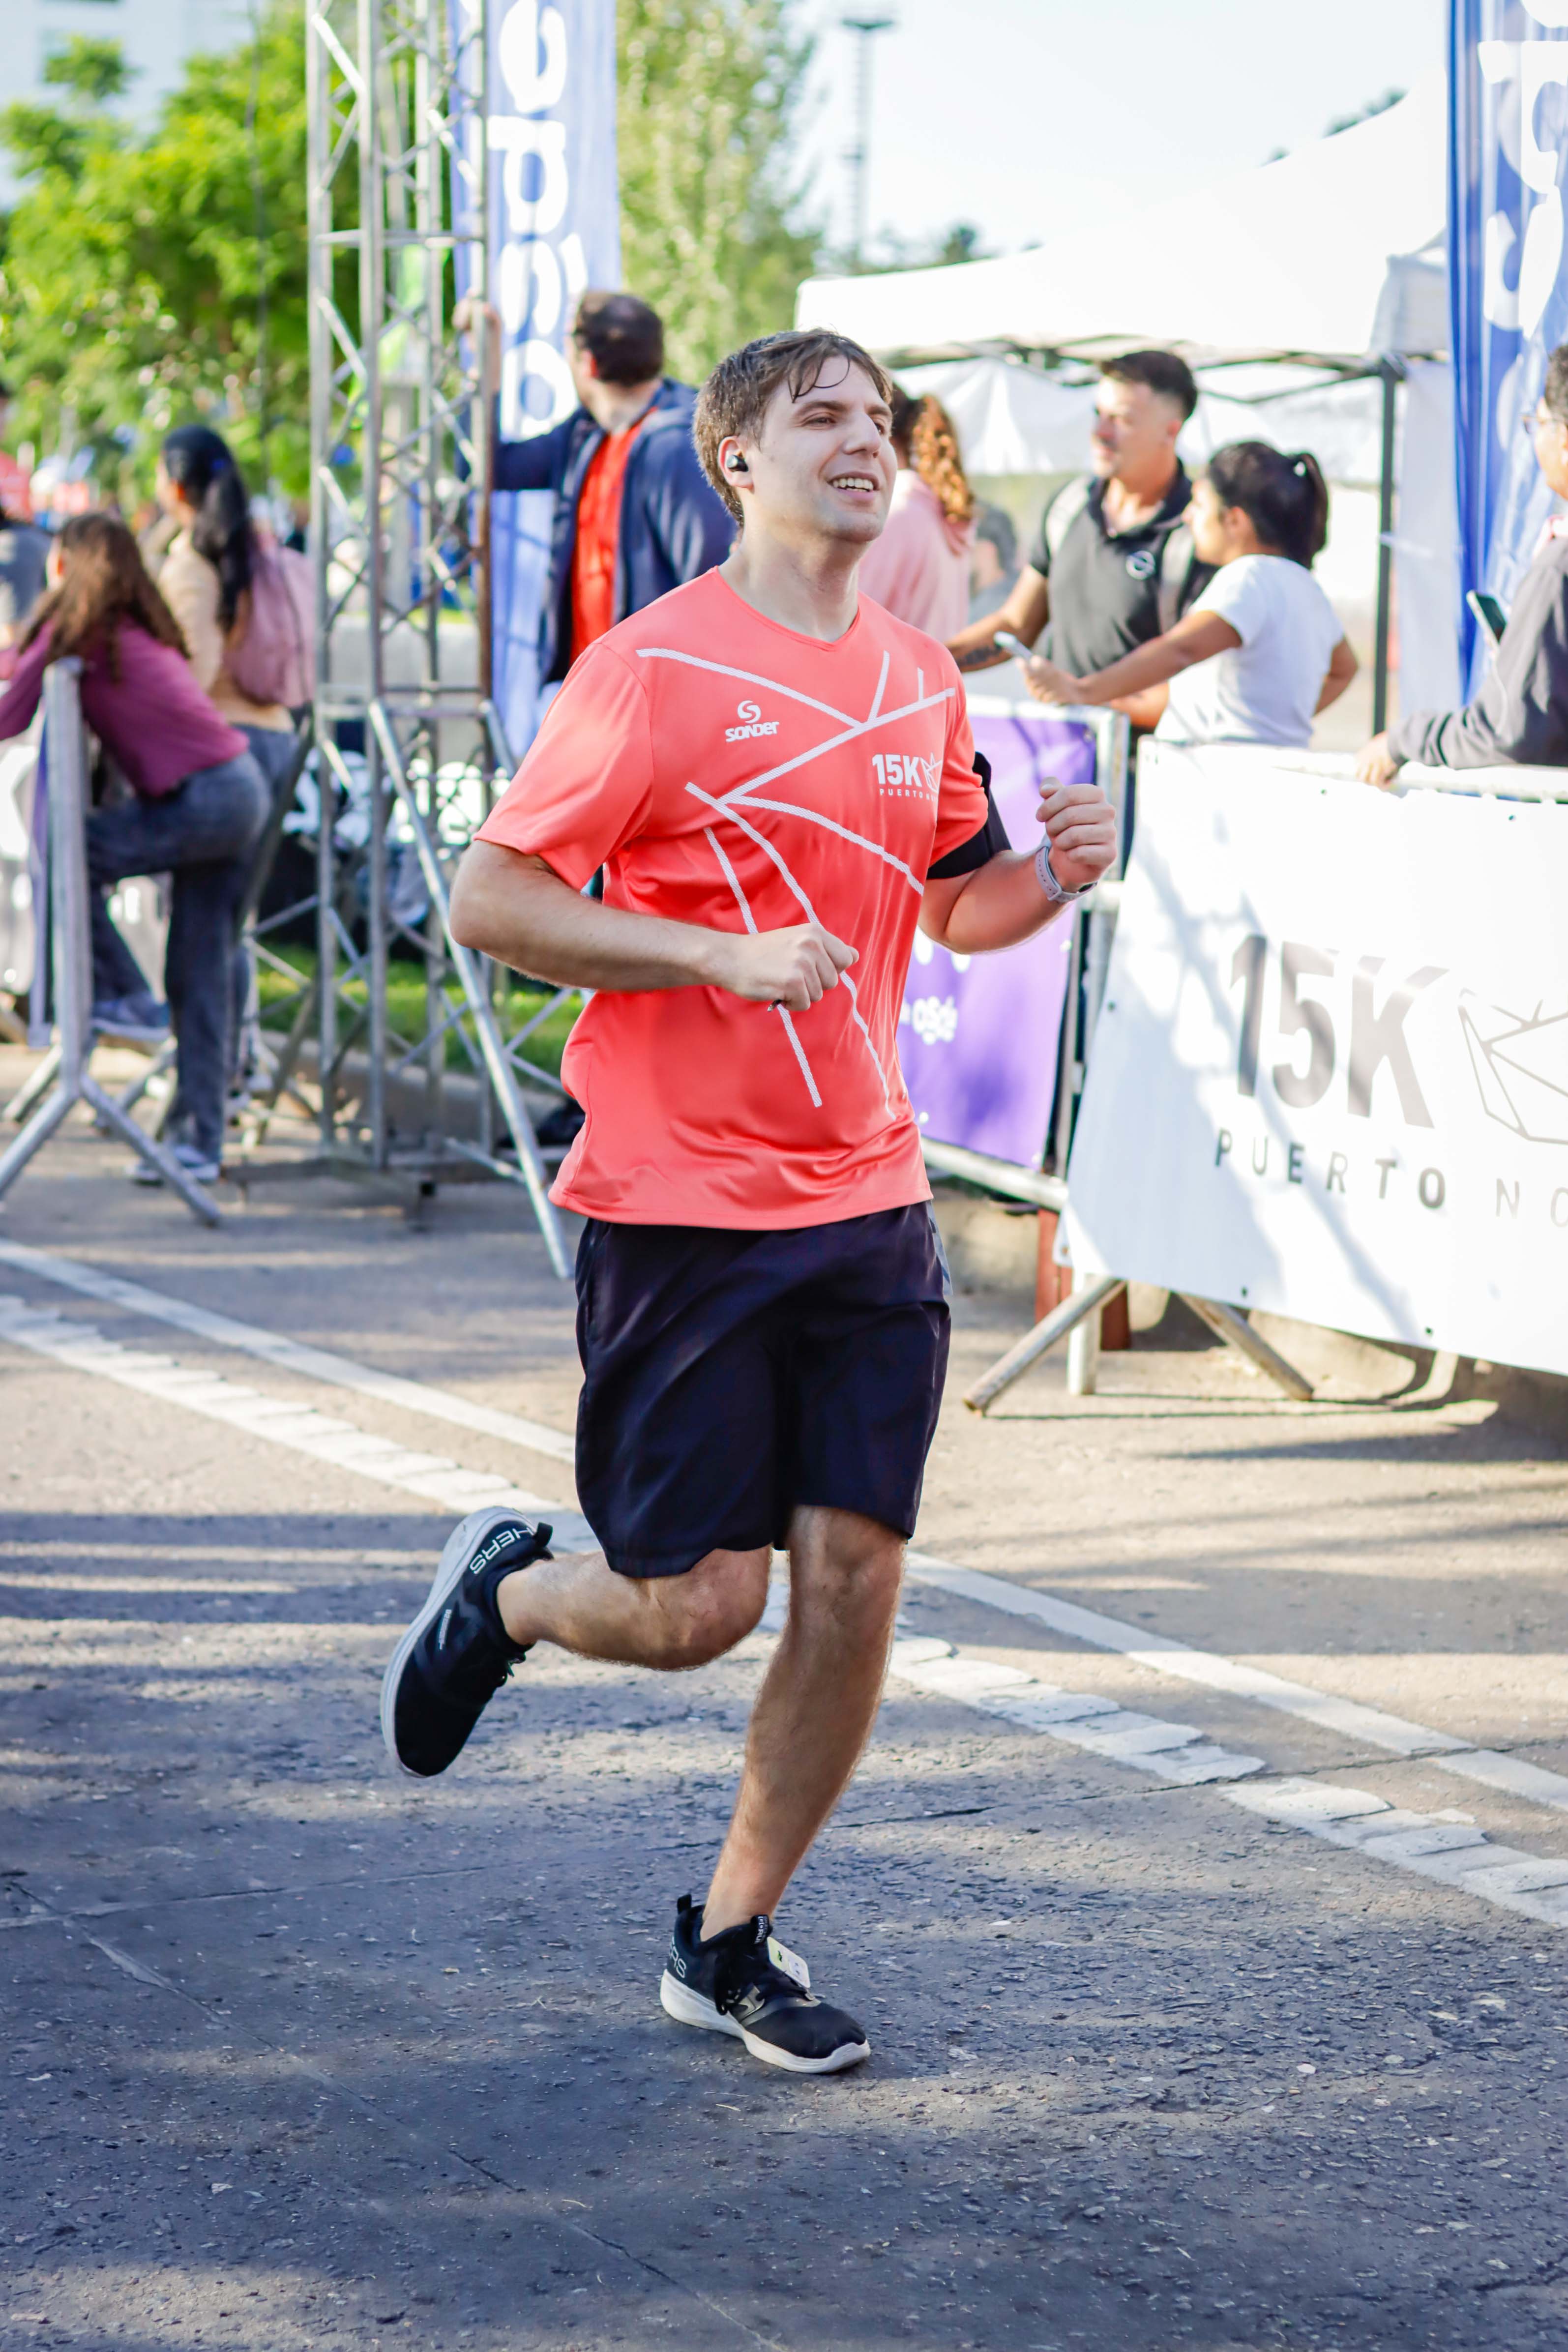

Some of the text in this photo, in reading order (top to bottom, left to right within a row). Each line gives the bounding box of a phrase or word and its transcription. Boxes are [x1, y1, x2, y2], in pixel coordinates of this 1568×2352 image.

[872, 754, 922, 787] 15K
[879, 788, 923, 799] PUERTO
[1230, 934, 1450, 1129] 15K
[1215, 1128, 1446, 1209] PUERTO
